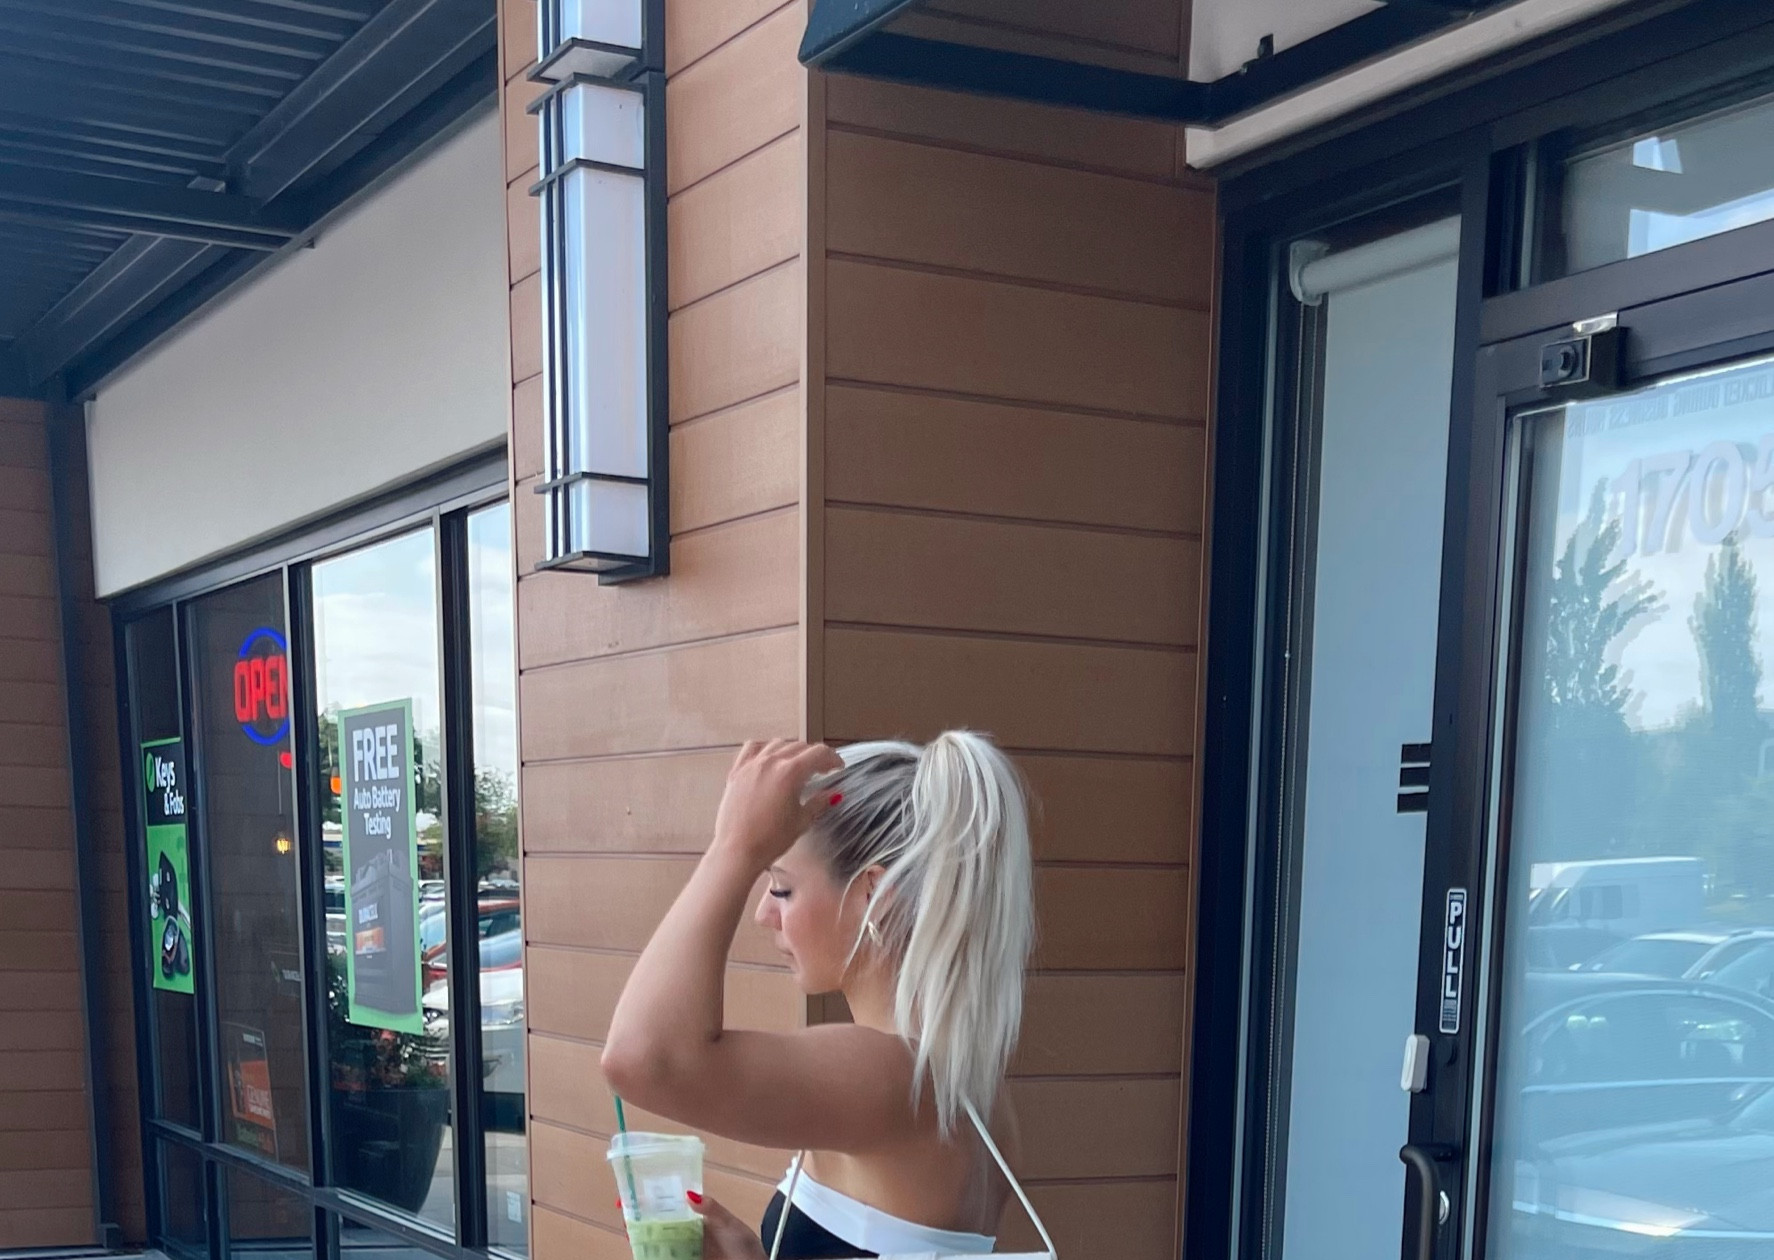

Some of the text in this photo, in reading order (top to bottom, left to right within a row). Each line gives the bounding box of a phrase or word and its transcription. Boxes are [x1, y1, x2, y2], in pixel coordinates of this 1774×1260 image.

[352, 724, 400, 782] FREE
[155, 757, 176, 793] Keys
[164, 789, 185, 816] & Fobs
[354, 785, 400, 812] Auto Battery
[364, 810, 392, 839] Testing
[1445, 901, 1463, 998] PULL
